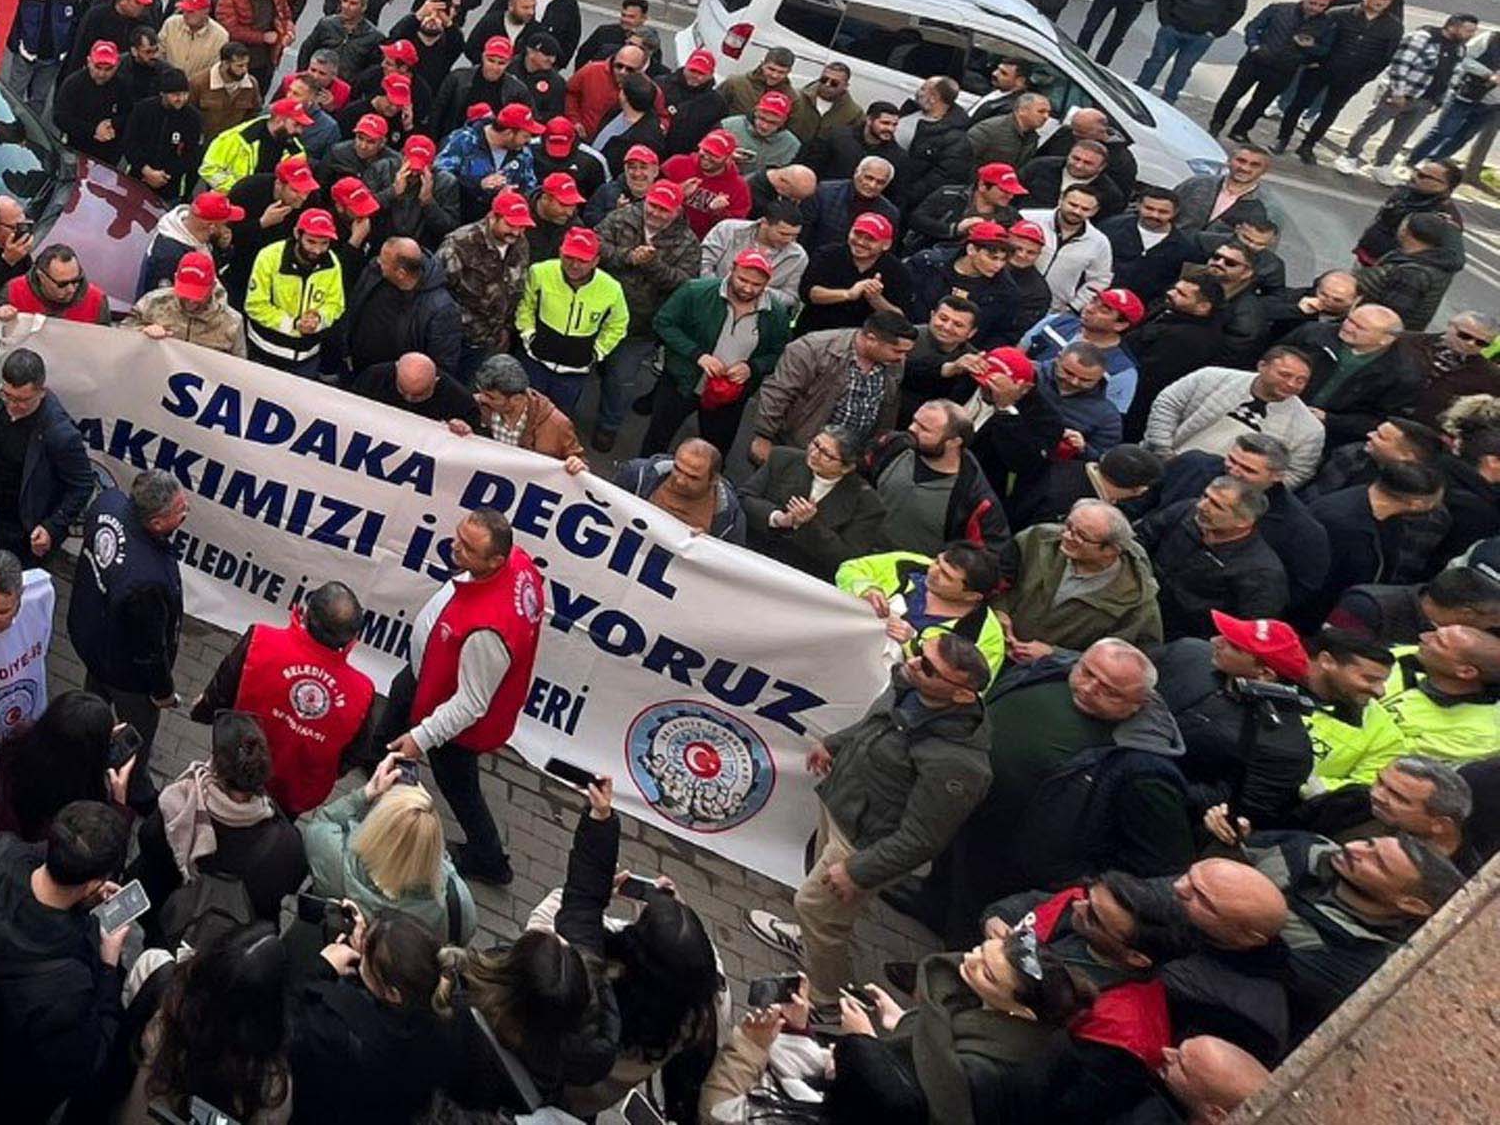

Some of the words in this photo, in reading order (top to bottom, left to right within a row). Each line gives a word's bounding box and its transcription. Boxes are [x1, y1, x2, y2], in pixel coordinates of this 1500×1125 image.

[77, 418, 386, 557] AKKIMIZI
[161, 372, 436, 496] SADAKA
[460, 470, 678, 600] DEĞİL
[168, 529, 286, 605] ELEDİYE
[524, 677, 591, 736] ERİ
